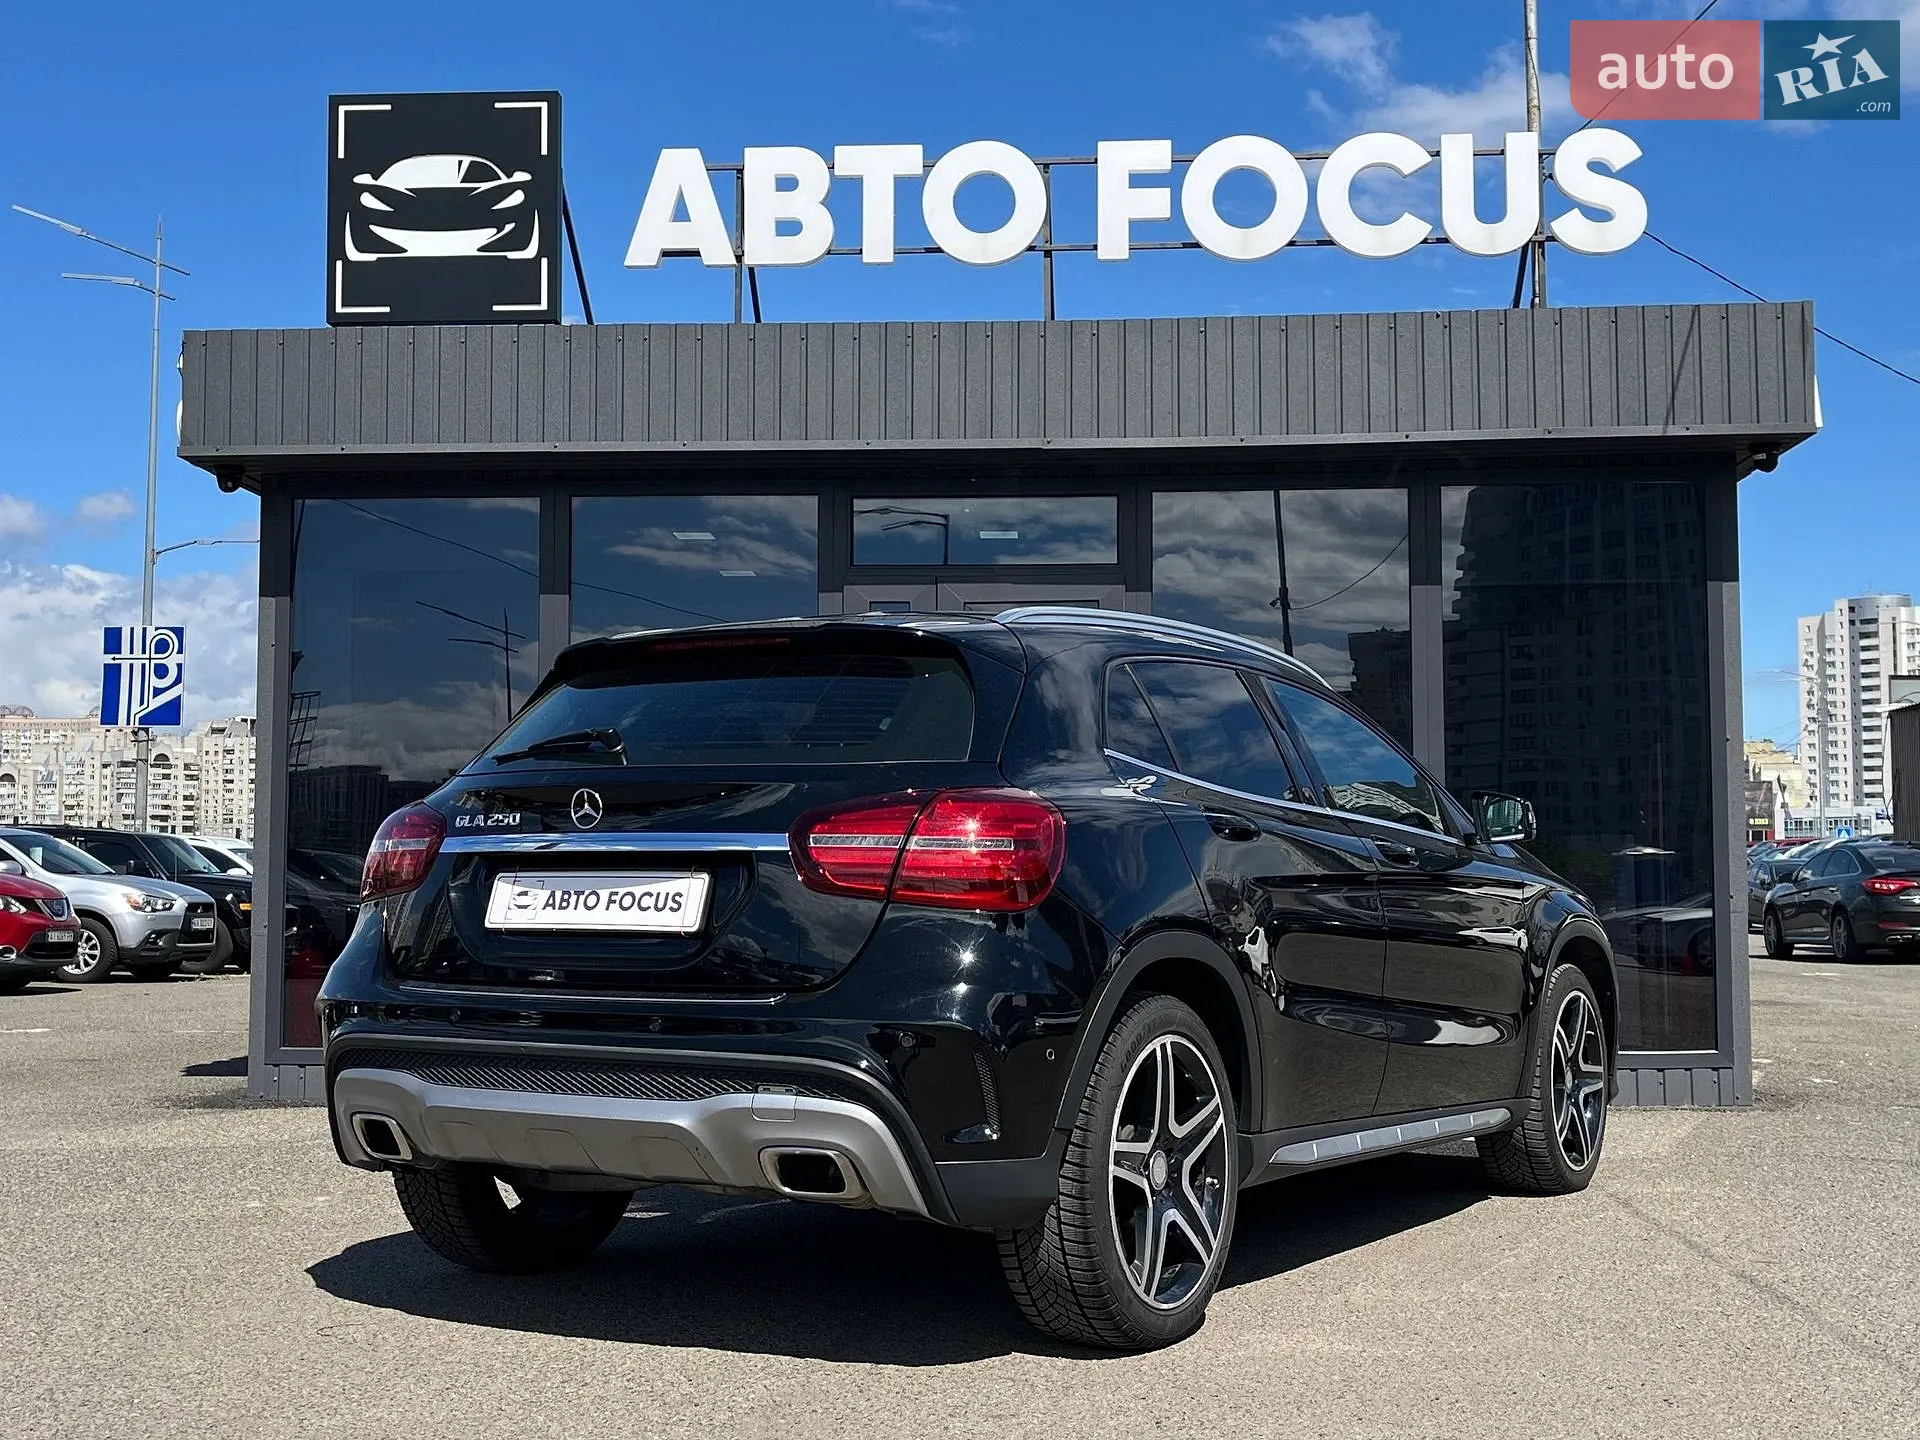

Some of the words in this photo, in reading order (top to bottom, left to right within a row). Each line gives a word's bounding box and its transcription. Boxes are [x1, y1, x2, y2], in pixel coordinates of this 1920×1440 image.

[623, 139, 1047, 267] АВТО
[1097, 127, 1648, 261] FOCUS
[455, 814, 485, 828] GLA
[486, 812, 521, 826] 250
[541, 890, 601, 911] АВТО
[605, 890, 684, 913] FOCUS
